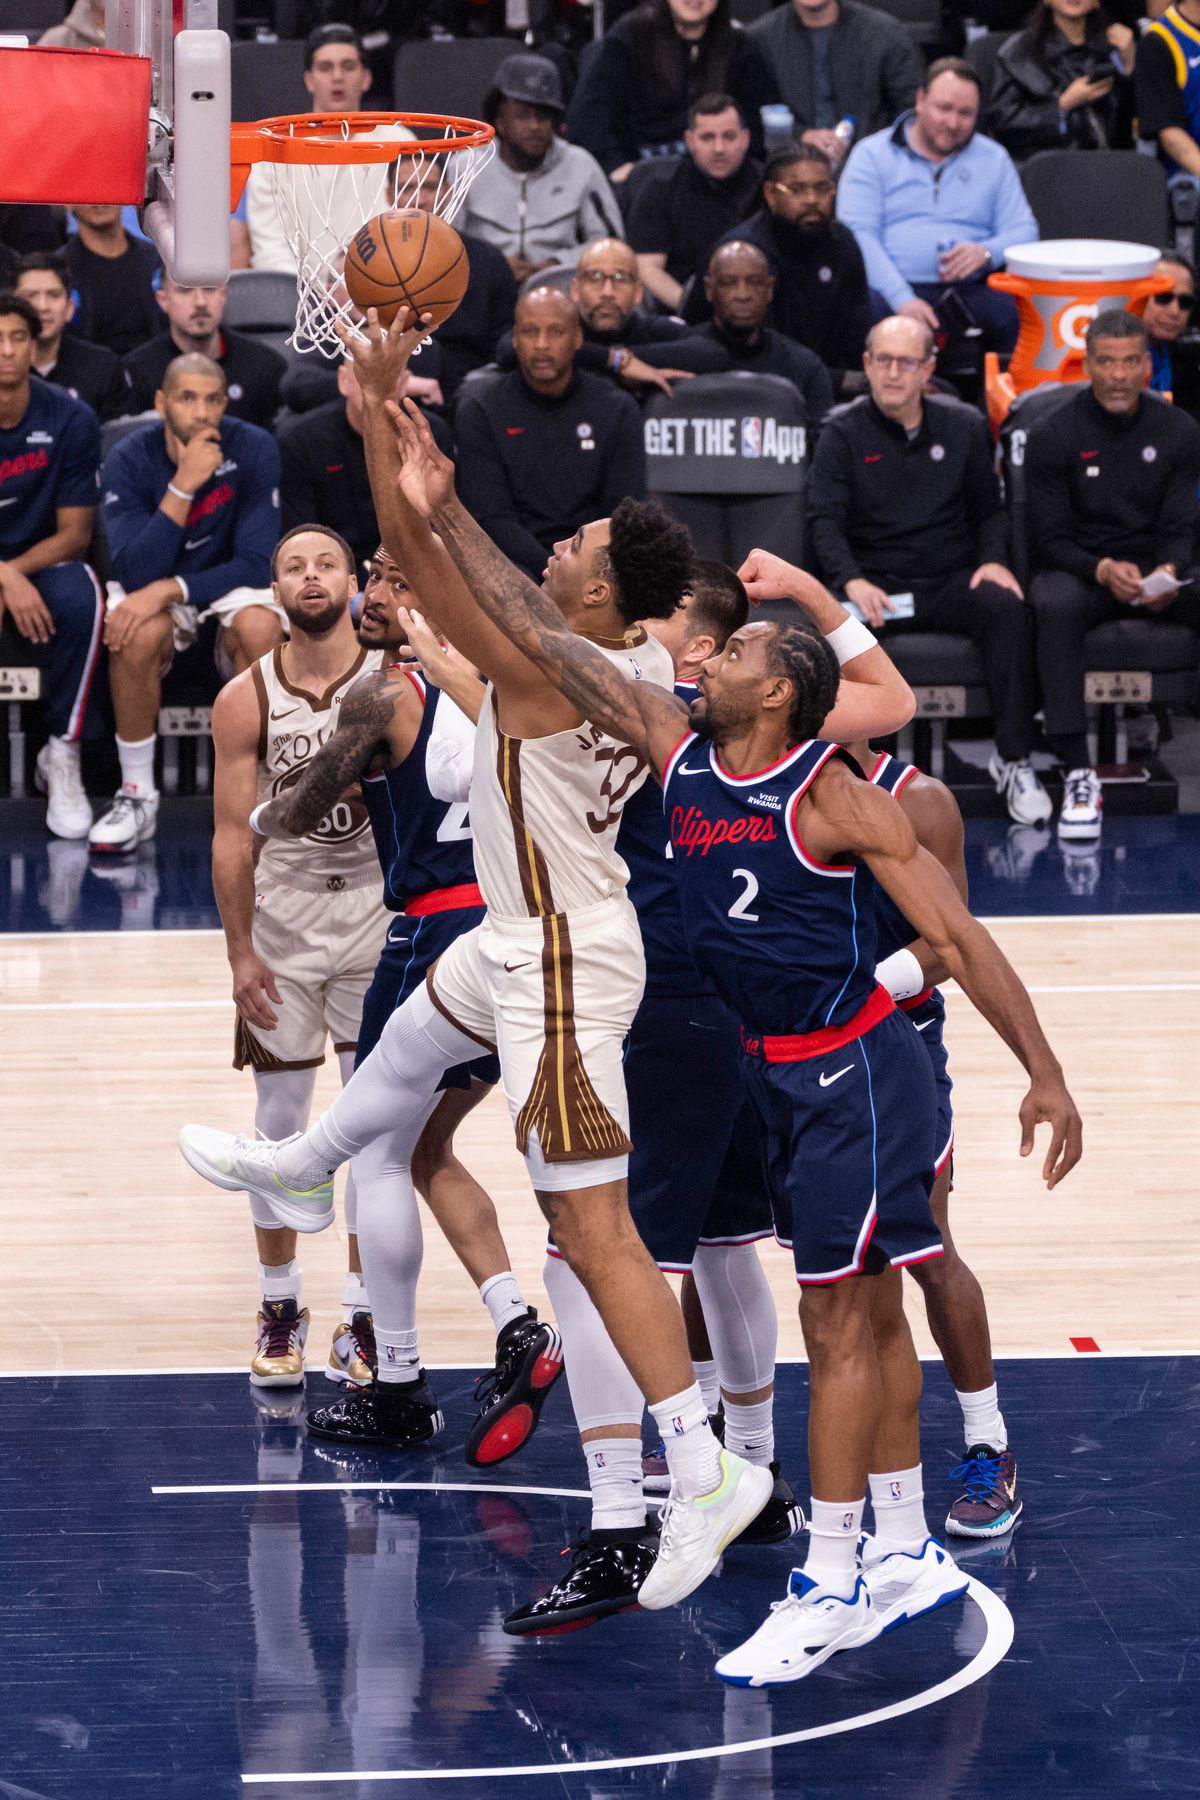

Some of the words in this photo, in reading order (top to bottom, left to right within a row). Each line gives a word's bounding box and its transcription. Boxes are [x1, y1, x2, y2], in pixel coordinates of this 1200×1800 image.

[644, 417, 688, 456] GET
[691, 417, 736, 456] THE
[762, 417, 806, 465] App
[272, 732, 293, 752] The
[586, 745, 649, 834] 32
[747, 795, 782, 811] RWANDA
[760, 792, 779, 803] VISIT
[671, 805, 778, 857] Clippers
[727, 867, 760, 922] 2
